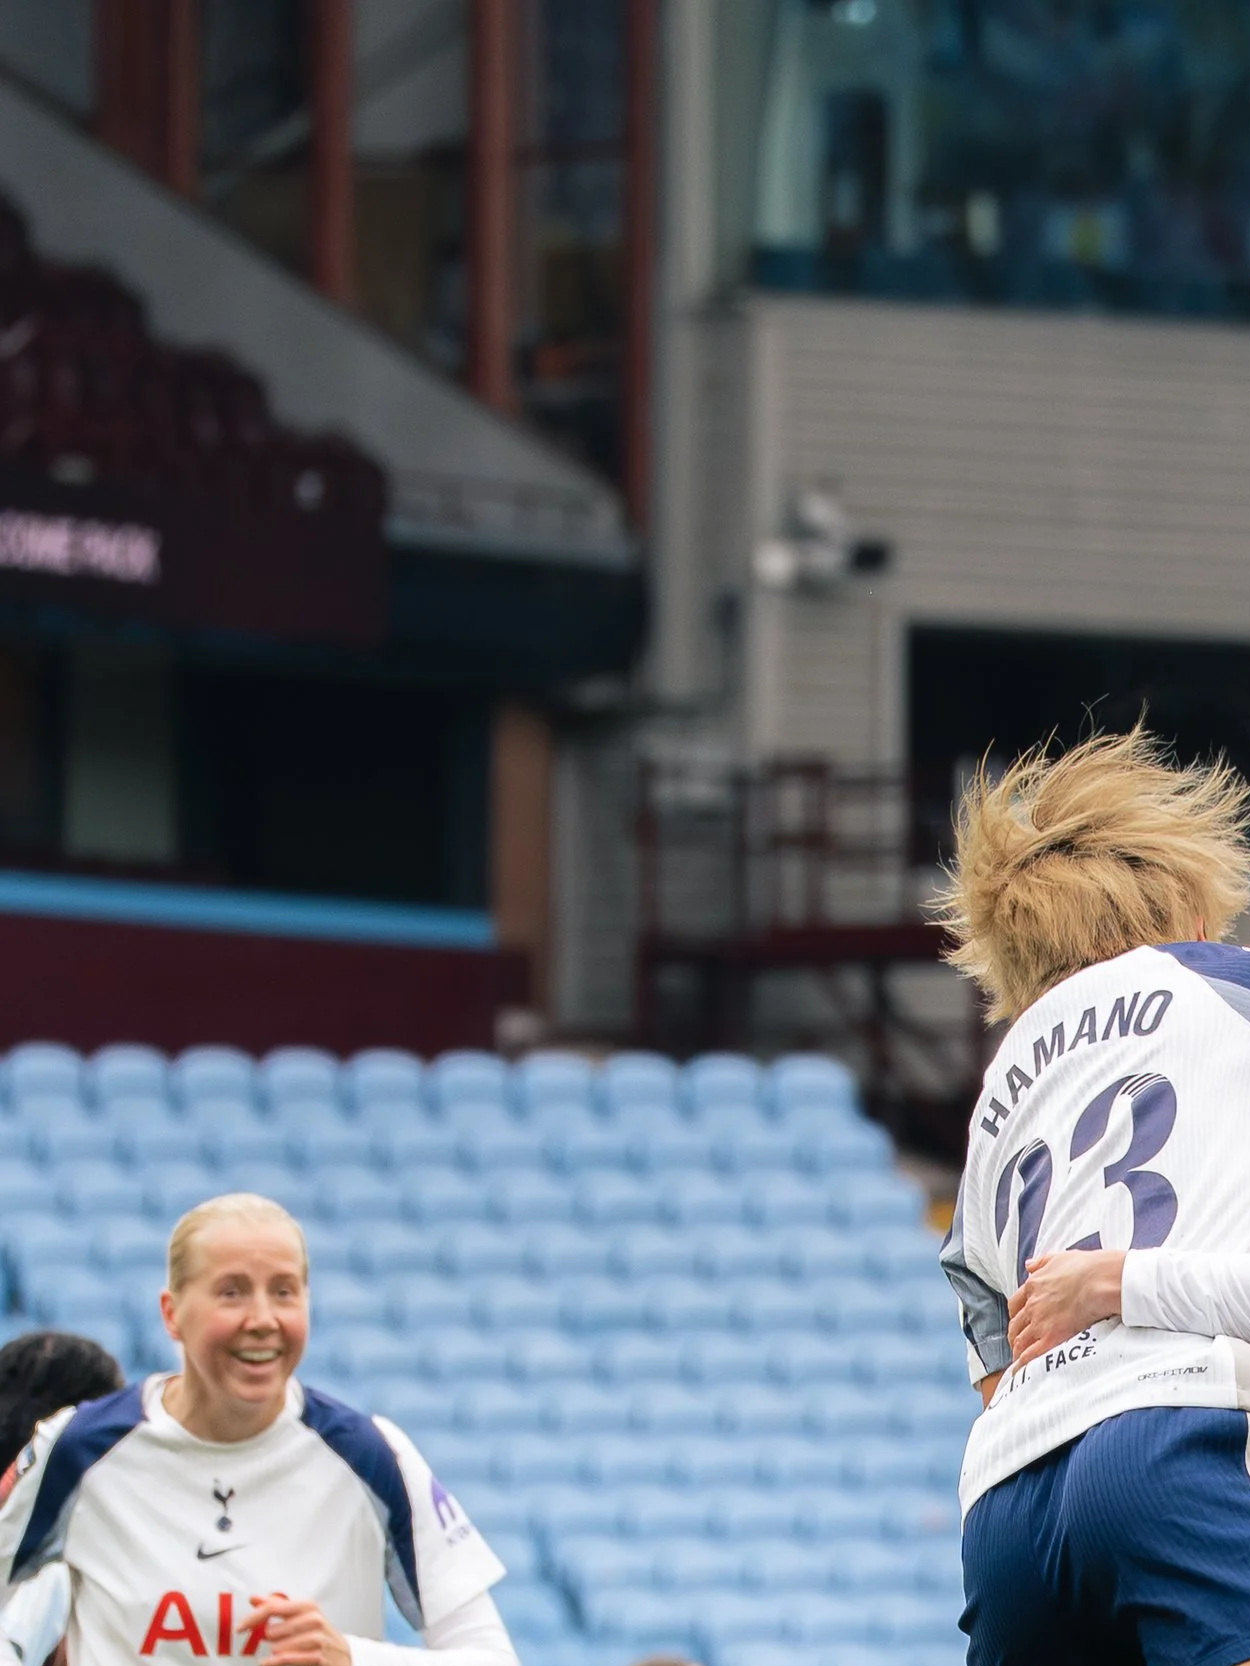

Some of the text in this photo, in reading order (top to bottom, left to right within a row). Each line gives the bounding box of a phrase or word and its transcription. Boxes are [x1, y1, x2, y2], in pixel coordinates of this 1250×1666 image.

[980, 989, 1174, 1139] HAMANO
[995, 1072, 1179, 1288] 23
[1045, 1345, 1097, 1373] FACE.
